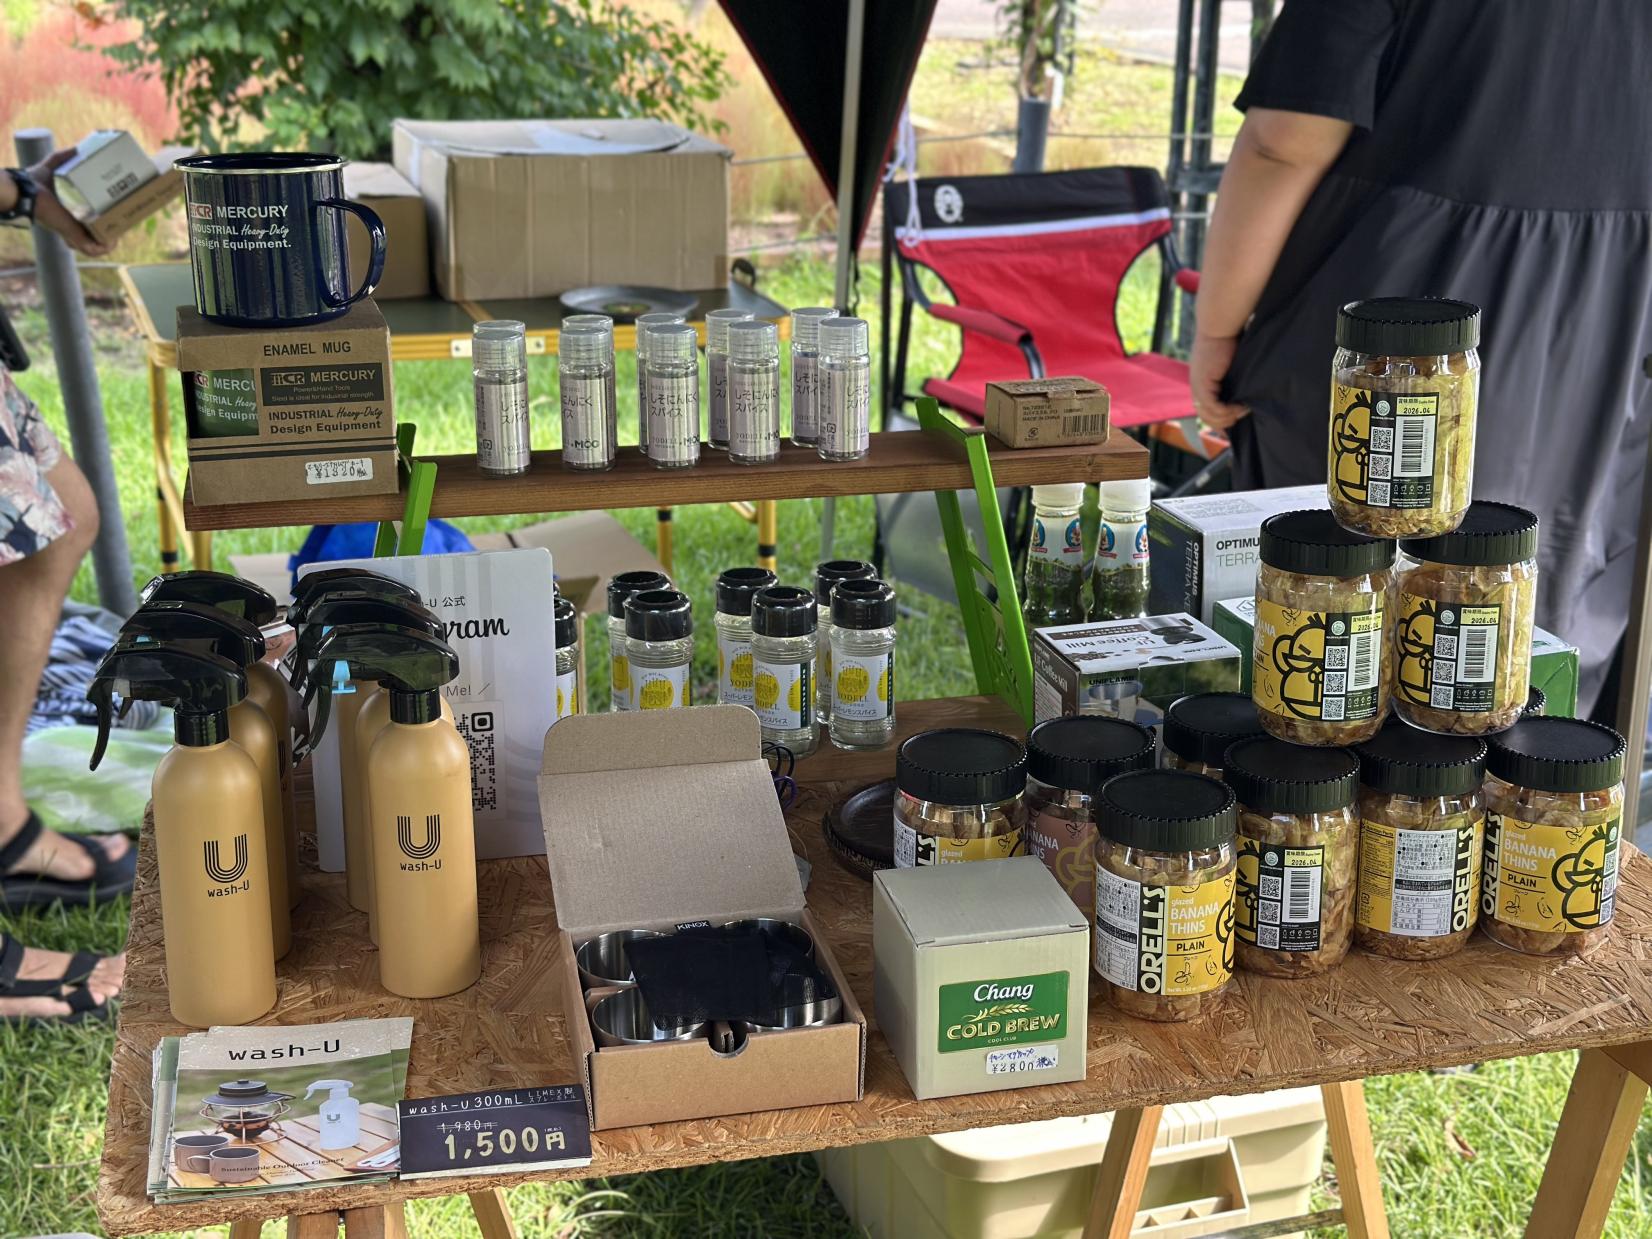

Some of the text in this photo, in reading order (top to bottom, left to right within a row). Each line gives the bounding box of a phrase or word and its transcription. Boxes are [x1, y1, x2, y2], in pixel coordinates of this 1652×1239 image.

[217, 205, 288, 218] MERCURY
[192, 223, 291, 239] INDUSTRIAL Heavy-Duty
[193, 237, 292, 250] Design Equipment.
[264, 341, 352, 356] ENAMEL MUG
[311, 369, 376, 382] MERCURY
[269, 406, 383, 422] INDUSTRIAL Heavy-Duty
[270, 422, 382, 435] Design Equipment
[1216, 537, 1261, 551] OPTIMU
[443, 596, 466, 608] 公式
[446, 684, 471, 697] Me!
[1504, 838, 1557, 859] BANANA
[400, 859, 442, 872] wash-U
[1503, 851, 1538, 871] THINS
[1453, 826, 1475, 932] ORELL'S
[1507, 873, 1537, 889] PLAIN
[207, 880, 250, 898] wash-U
[1170, 901, 1219, 921] BANANA
[677, 921, 709, 931] KINOX
[1170, 920, 1206, 935] THINS
[1140, 886, 1165, 994] ORELL'S
[1176, 940, 1205, 952] PLAIN
[973, 983, 1034, 1003] Chang
[946, 1013, 1060, 1040] COLD BREW
[228, 1039, 341, 1061] wash-U
[409, 1093, 524, 1115] wash-U 300mL
[444, 1126, 566, 1160] 1,500円
[221, 1164, 271, 1173] Sustainable
[272, 1160, 310, 1169] Outdoor
[311, 1157, 345, 1166] Cleaner
